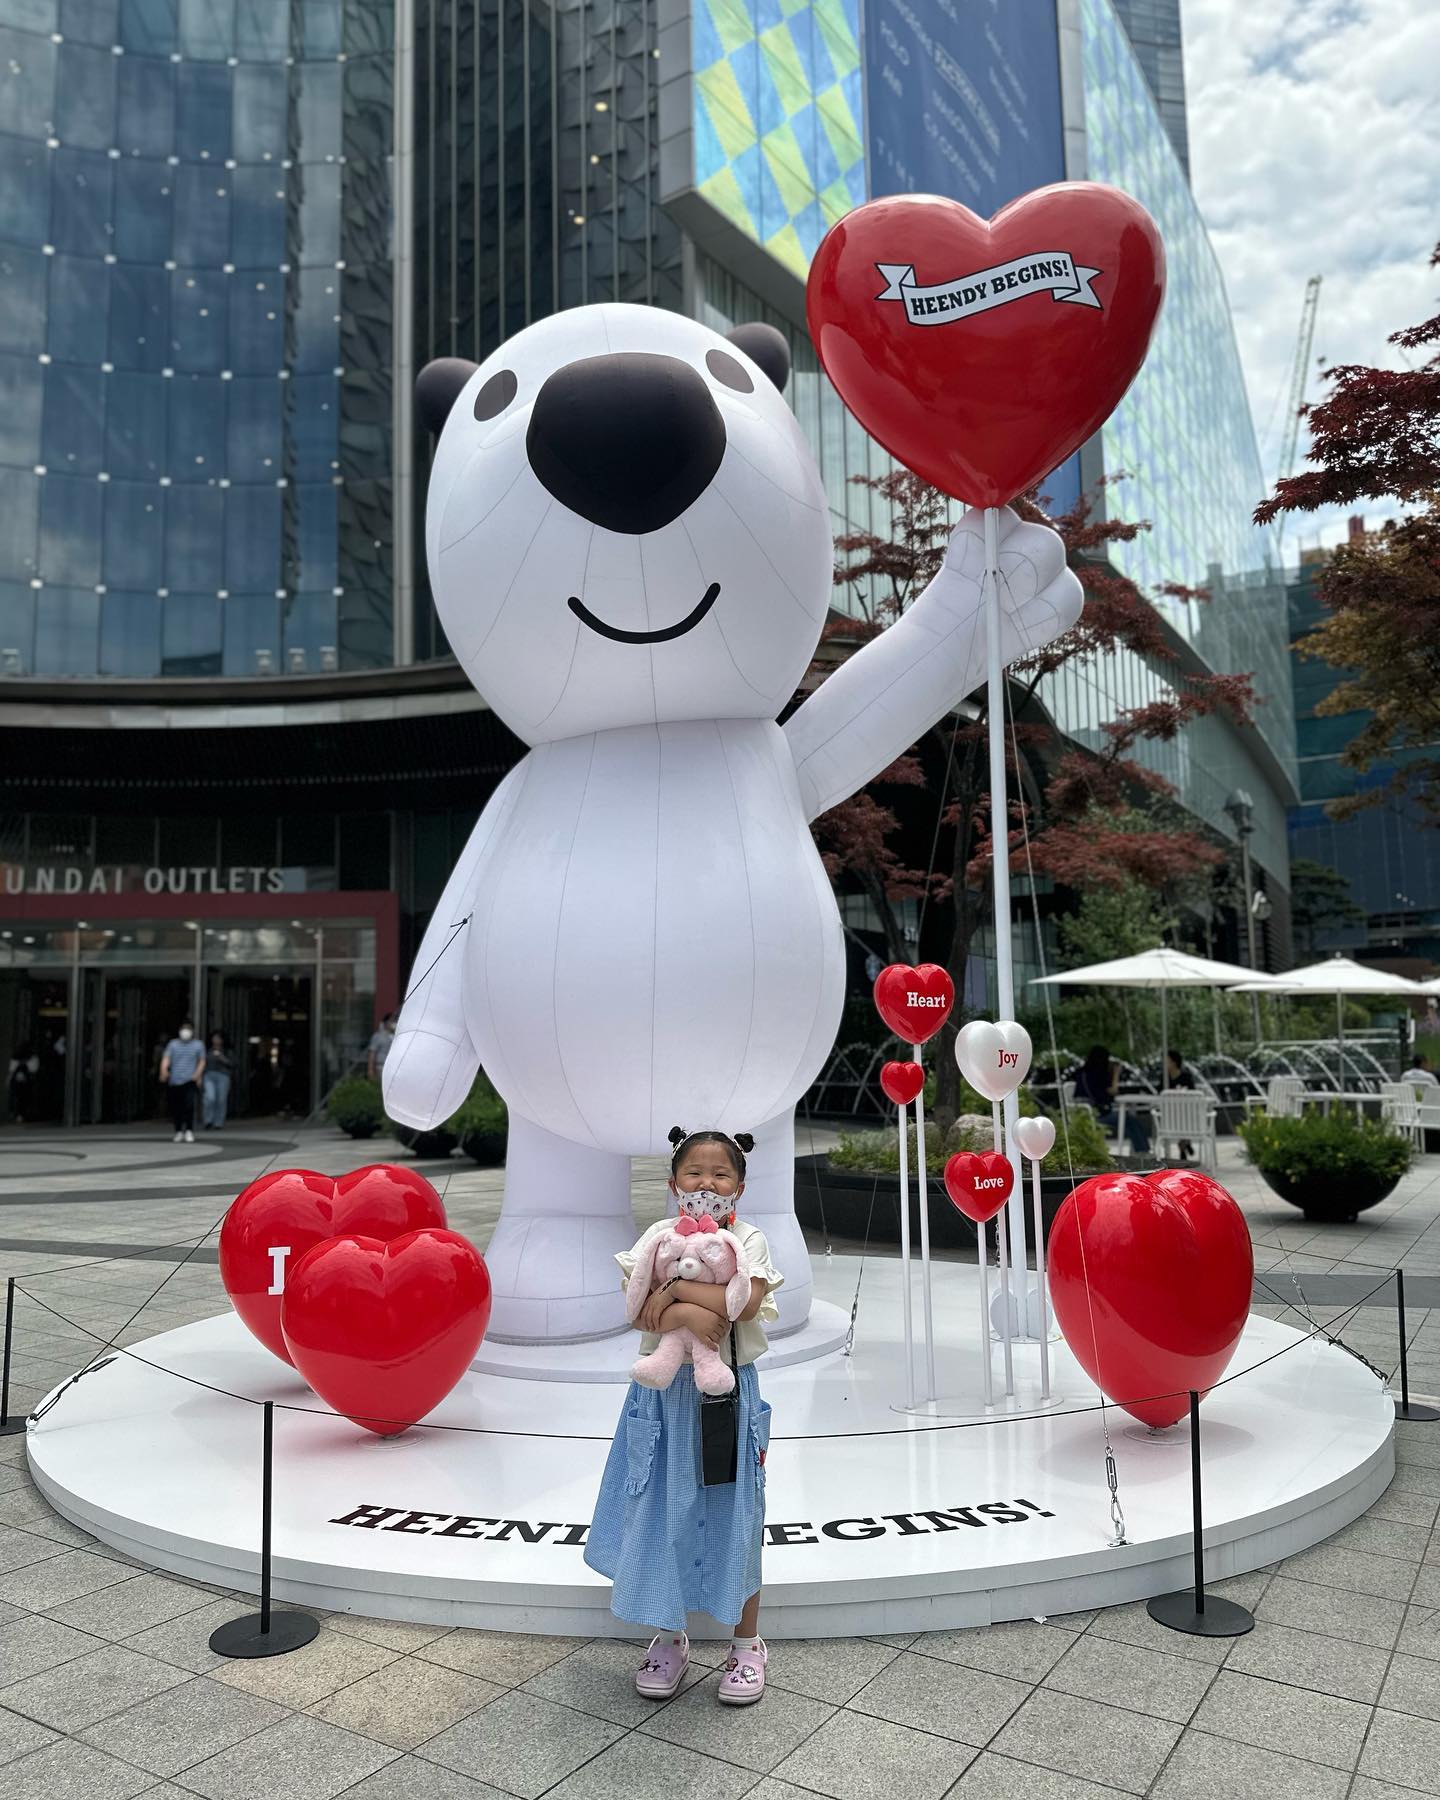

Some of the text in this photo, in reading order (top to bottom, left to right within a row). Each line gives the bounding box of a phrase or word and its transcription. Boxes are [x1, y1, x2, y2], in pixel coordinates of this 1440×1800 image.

[911, 259, 1070, 316] HEENDY BEGINS!
[143, 866, 285, 895] OUTLETS
[907, 991, 946, 1009] Heart
[998, 1049, 1019, 1068] Joy
[974, 1176, 1005, 1190] Love
[267, 1246, 291, 1296] I
[761, 1498, 1057, 1548] EGINS!
